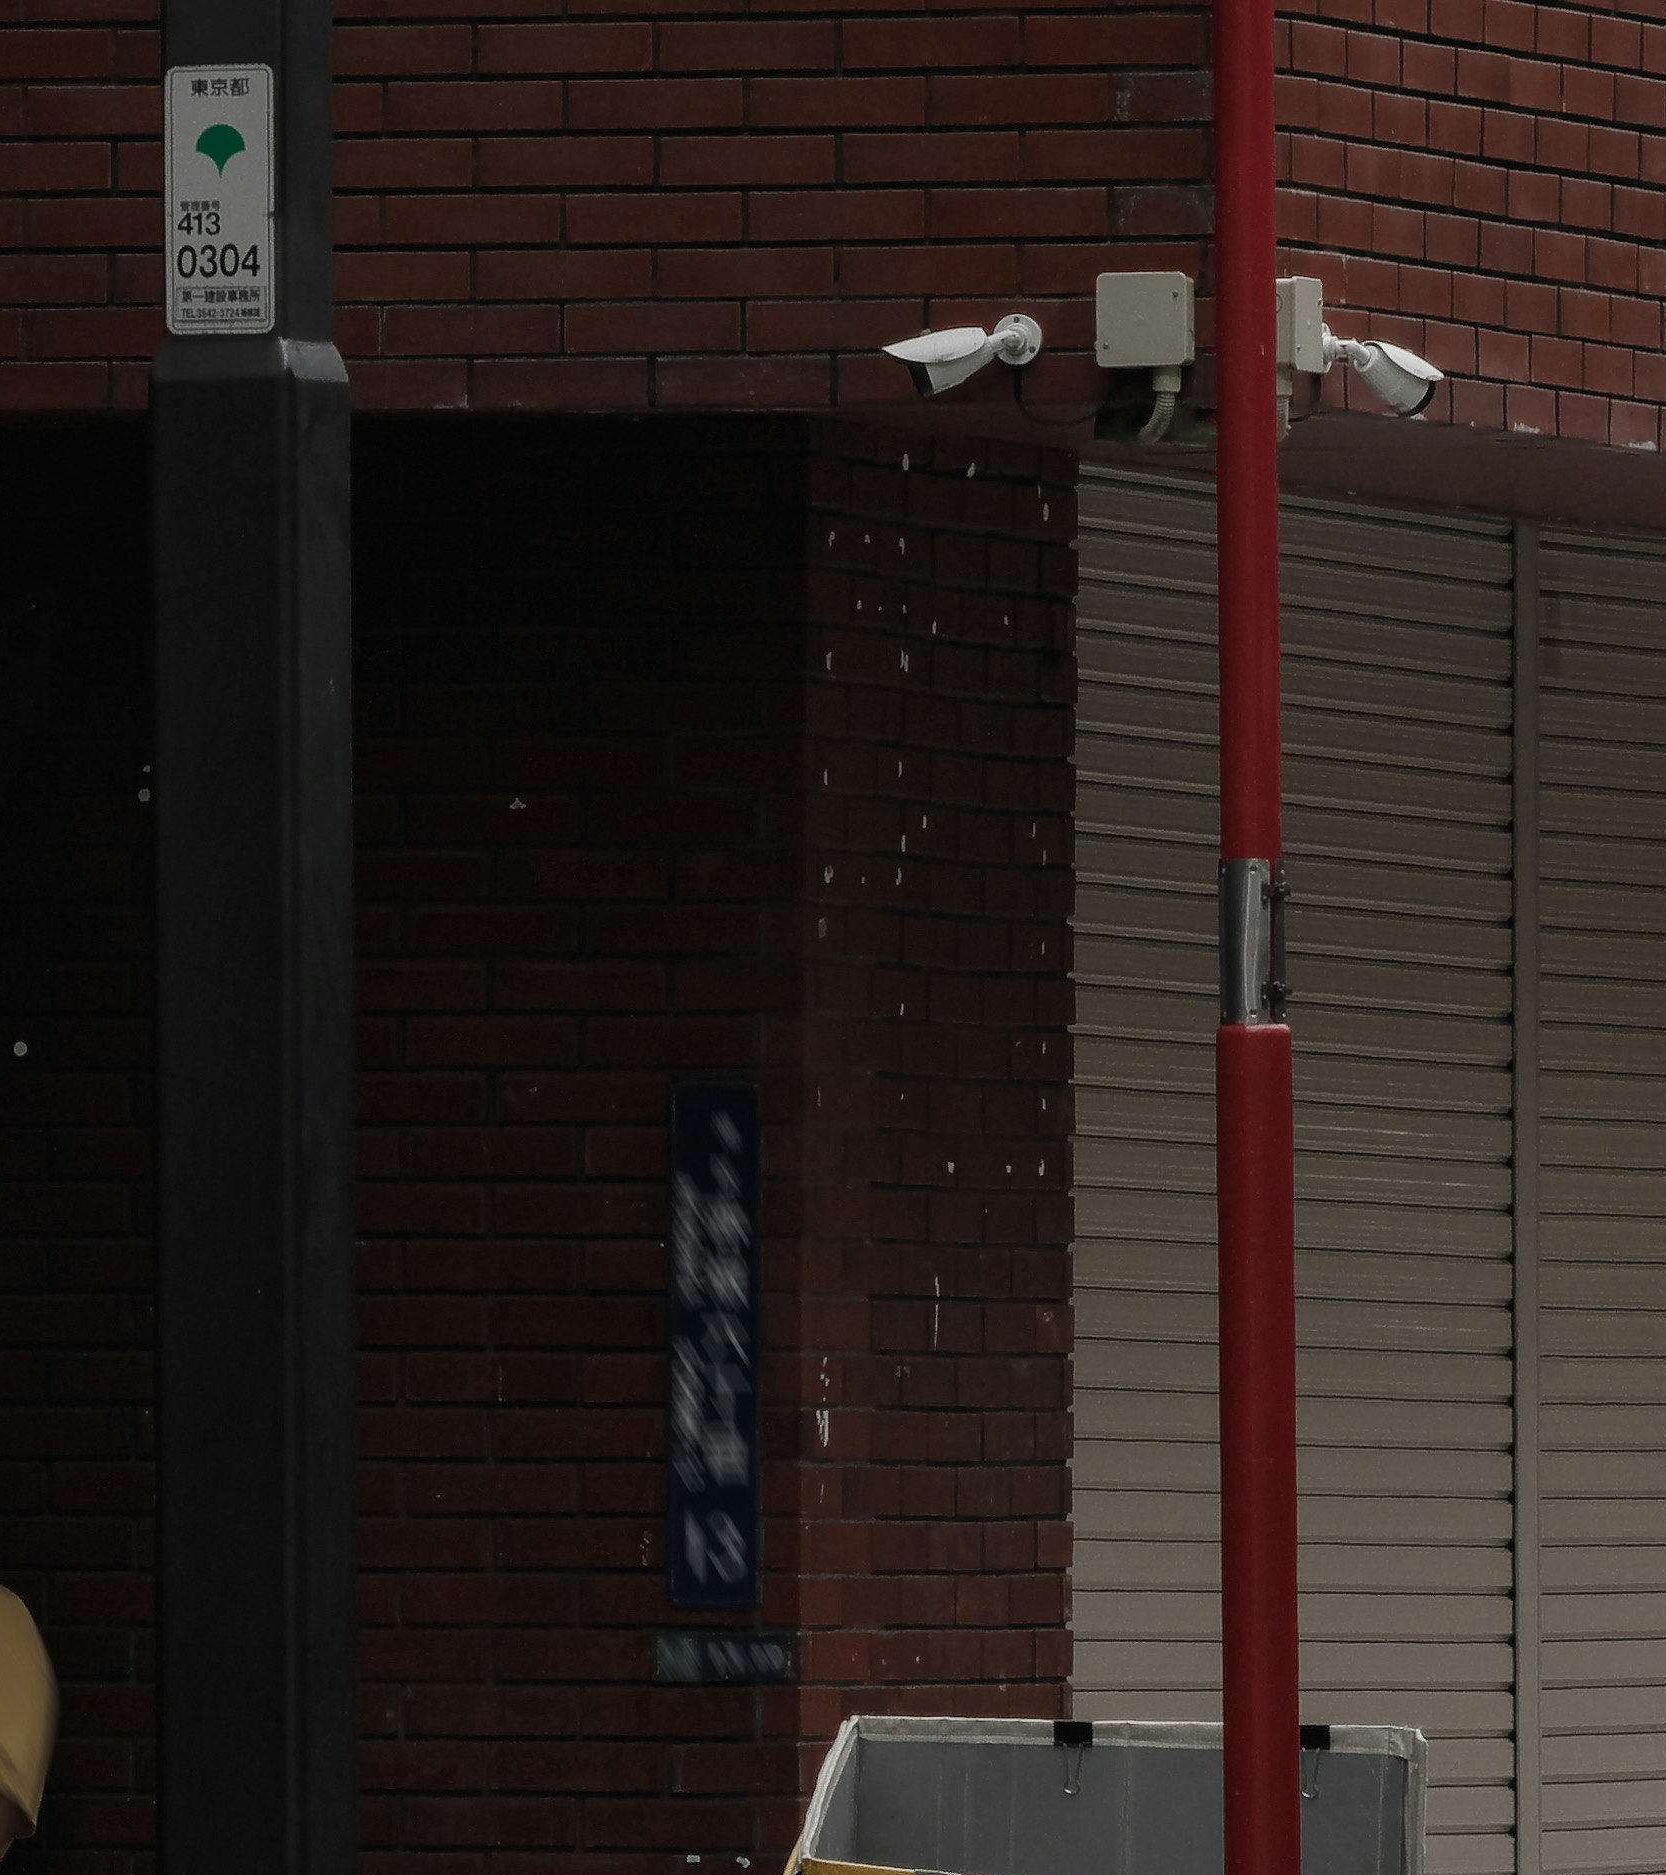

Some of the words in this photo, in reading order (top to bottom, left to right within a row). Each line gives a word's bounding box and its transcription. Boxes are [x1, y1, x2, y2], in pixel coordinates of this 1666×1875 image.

[191, 77, 250, 97] 東京都
[177, 212, 221, 235] 413
[177, 243, 260, 278] 0304
[181, 289, 260, 303] 第一建設事務所
